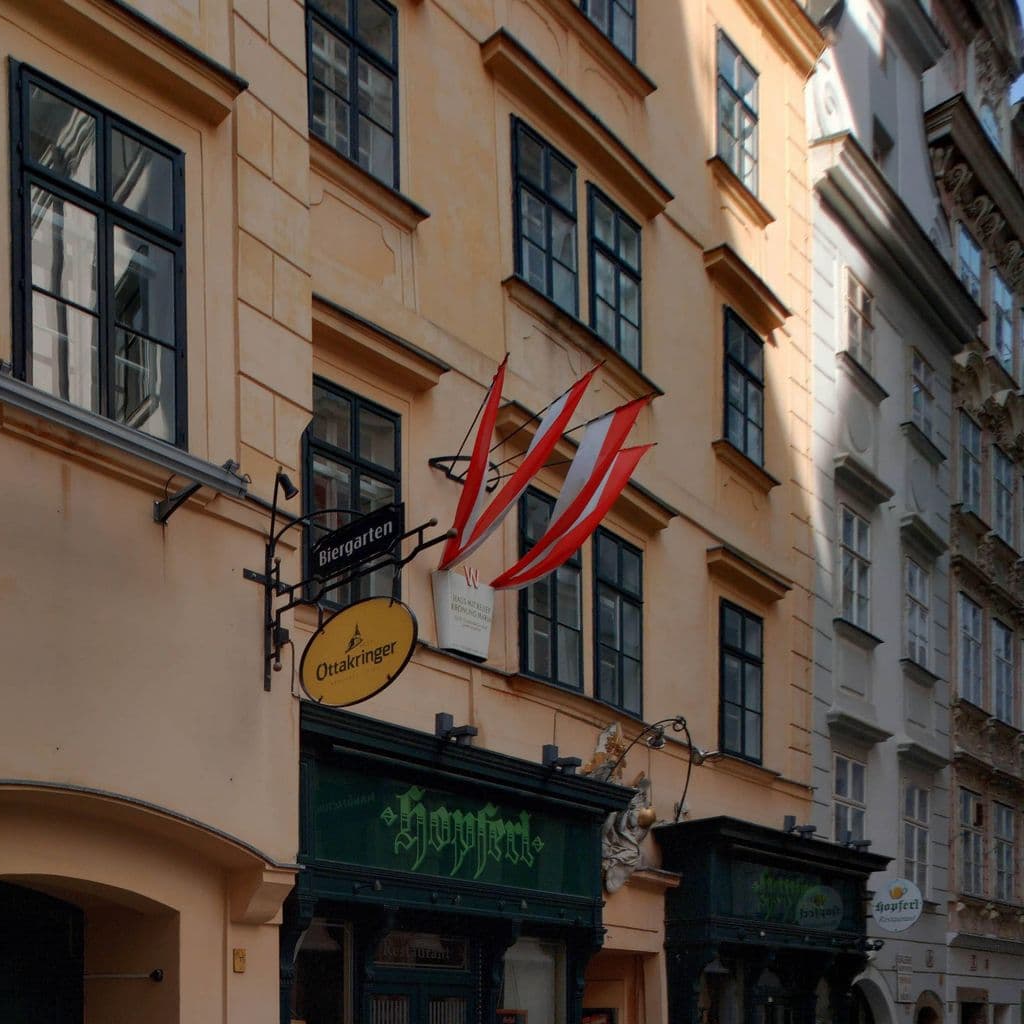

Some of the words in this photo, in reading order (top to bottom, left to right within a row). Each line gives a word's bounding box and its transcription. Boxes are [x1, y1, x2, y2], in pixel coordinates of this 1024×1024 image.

[319, 520, 393, 567] Biergarten
[315, 640, 397, 682] Ottakringer
[394, 785, 534, 880] Hopferl
[875, 899, 920, 914] Hopferl
